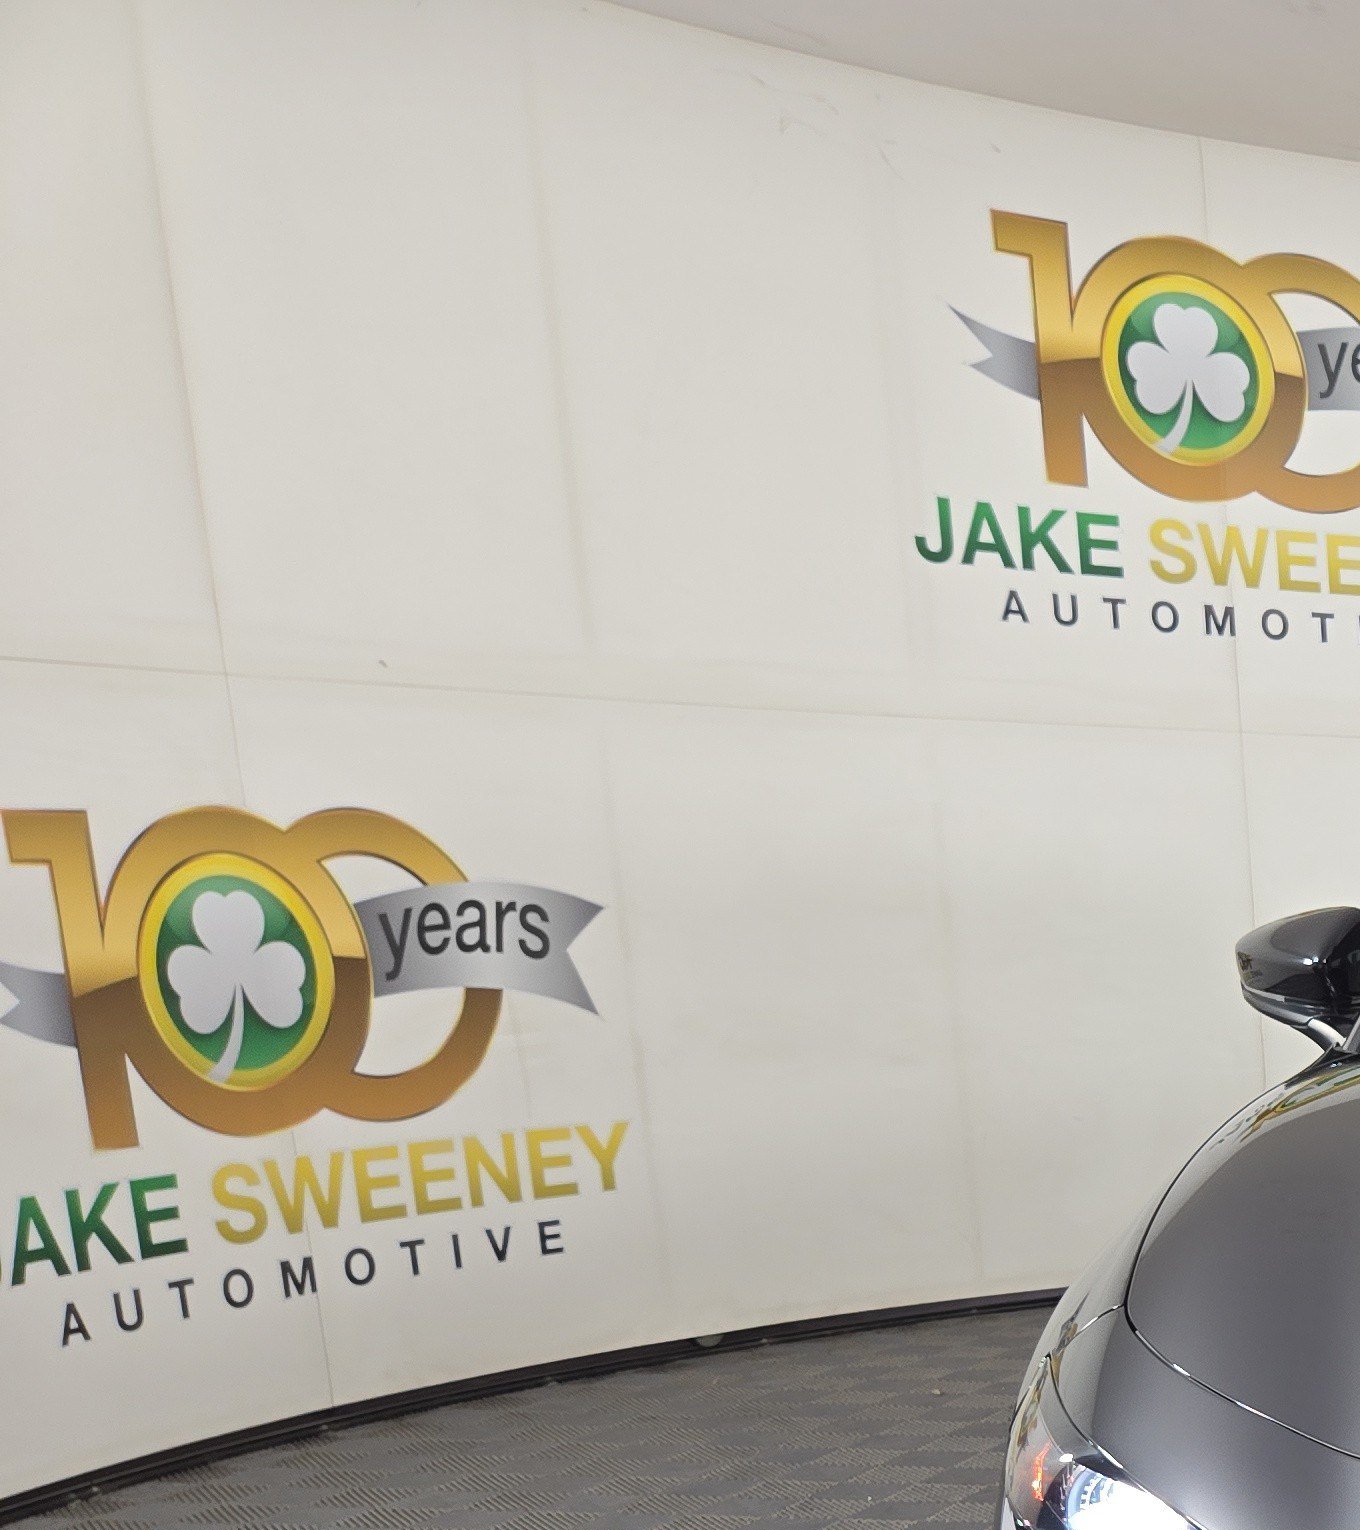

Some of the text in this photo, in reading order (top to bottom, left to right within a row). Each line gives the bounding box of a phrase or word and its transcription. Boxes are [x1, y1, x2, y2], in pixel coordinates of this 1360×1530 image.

[914, 496, 1124, 578] JAKE
[378, 899, 550, 980] years
[0, 1122, 629, 1286] AKE SWEENEY
[61, 1219, 563, 1346] AUTOMOTIVE
